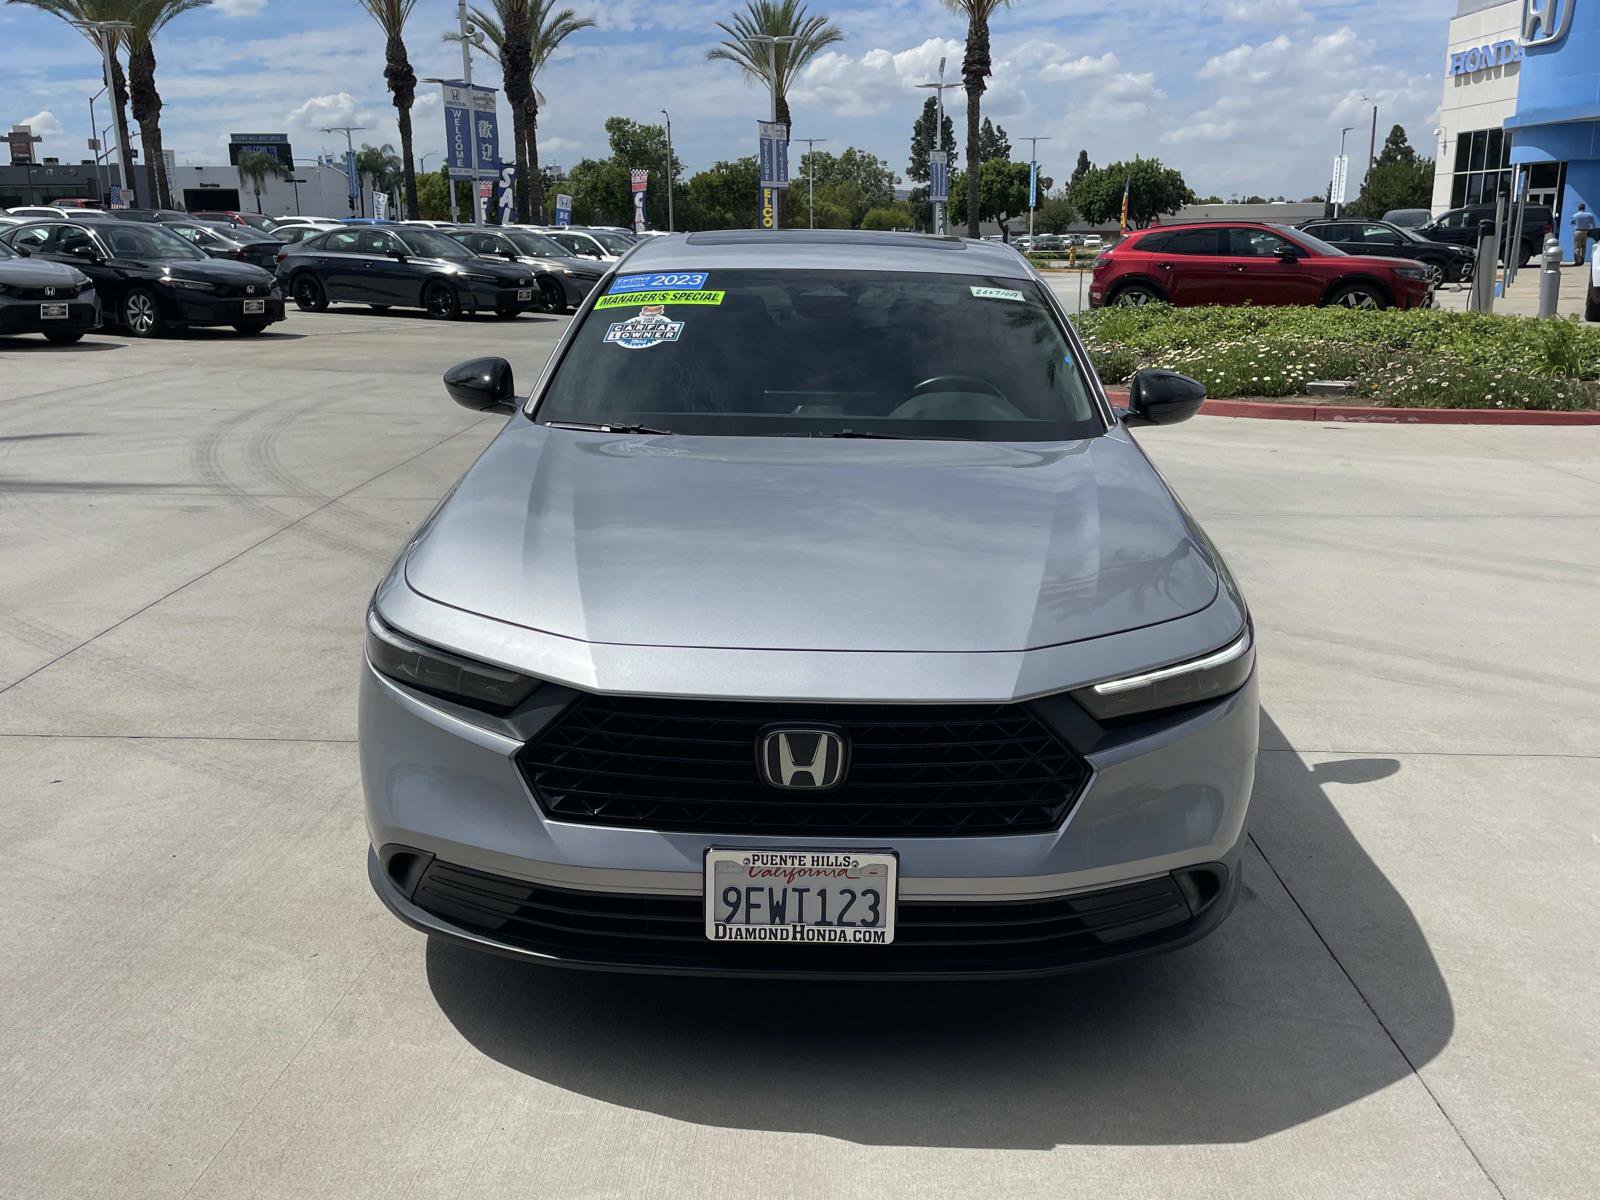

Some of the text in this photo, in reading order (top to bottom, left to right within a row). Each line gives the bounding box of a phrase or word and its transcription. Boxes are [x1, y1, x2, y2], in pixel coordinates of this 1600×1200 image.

[450, 108, 464, 167] WELCOME
[651, 274, 703, 286] 2023
[599, 291, 719, 306] MANAGER'S SPECIAL
[613, 323, 677, 332] CARFAX
[751, 854, 851, 867] PUENTE HILLS
[748, 866, 860, 885] California
[722, 886, 881, 928] 9FWT123
